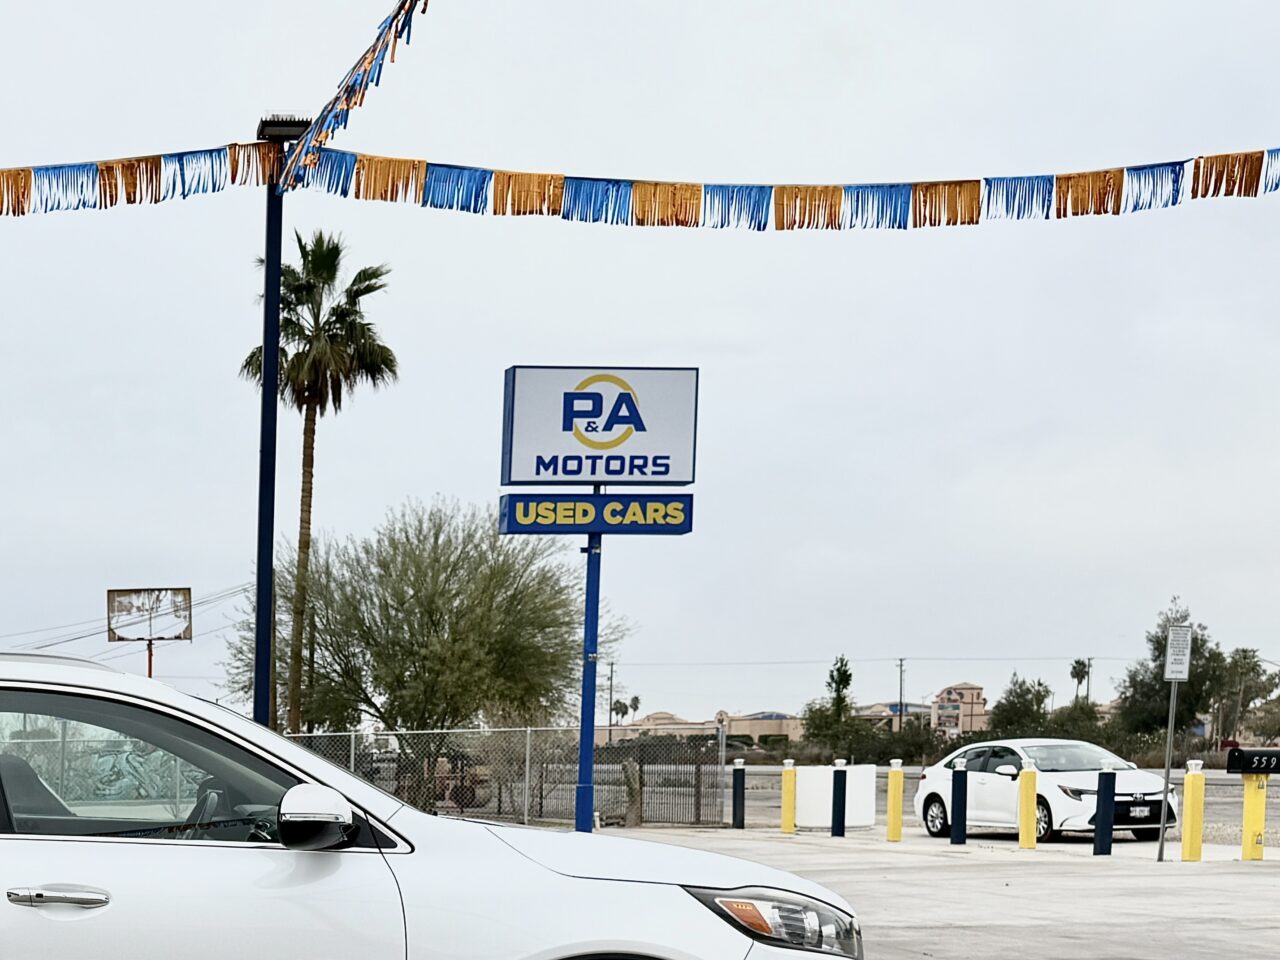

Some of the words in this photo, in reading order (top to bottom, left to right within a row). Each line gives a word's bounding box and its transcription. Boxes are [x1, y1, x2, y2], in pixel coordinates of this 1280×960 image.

[562, 392, 646, 432] P&A
[535, 455, 670, 475] MOTORS
[515, 502, 595, 524] USED
[603, 502, 685, 525] CARS
[1251, 756, 1277, 768] 559
